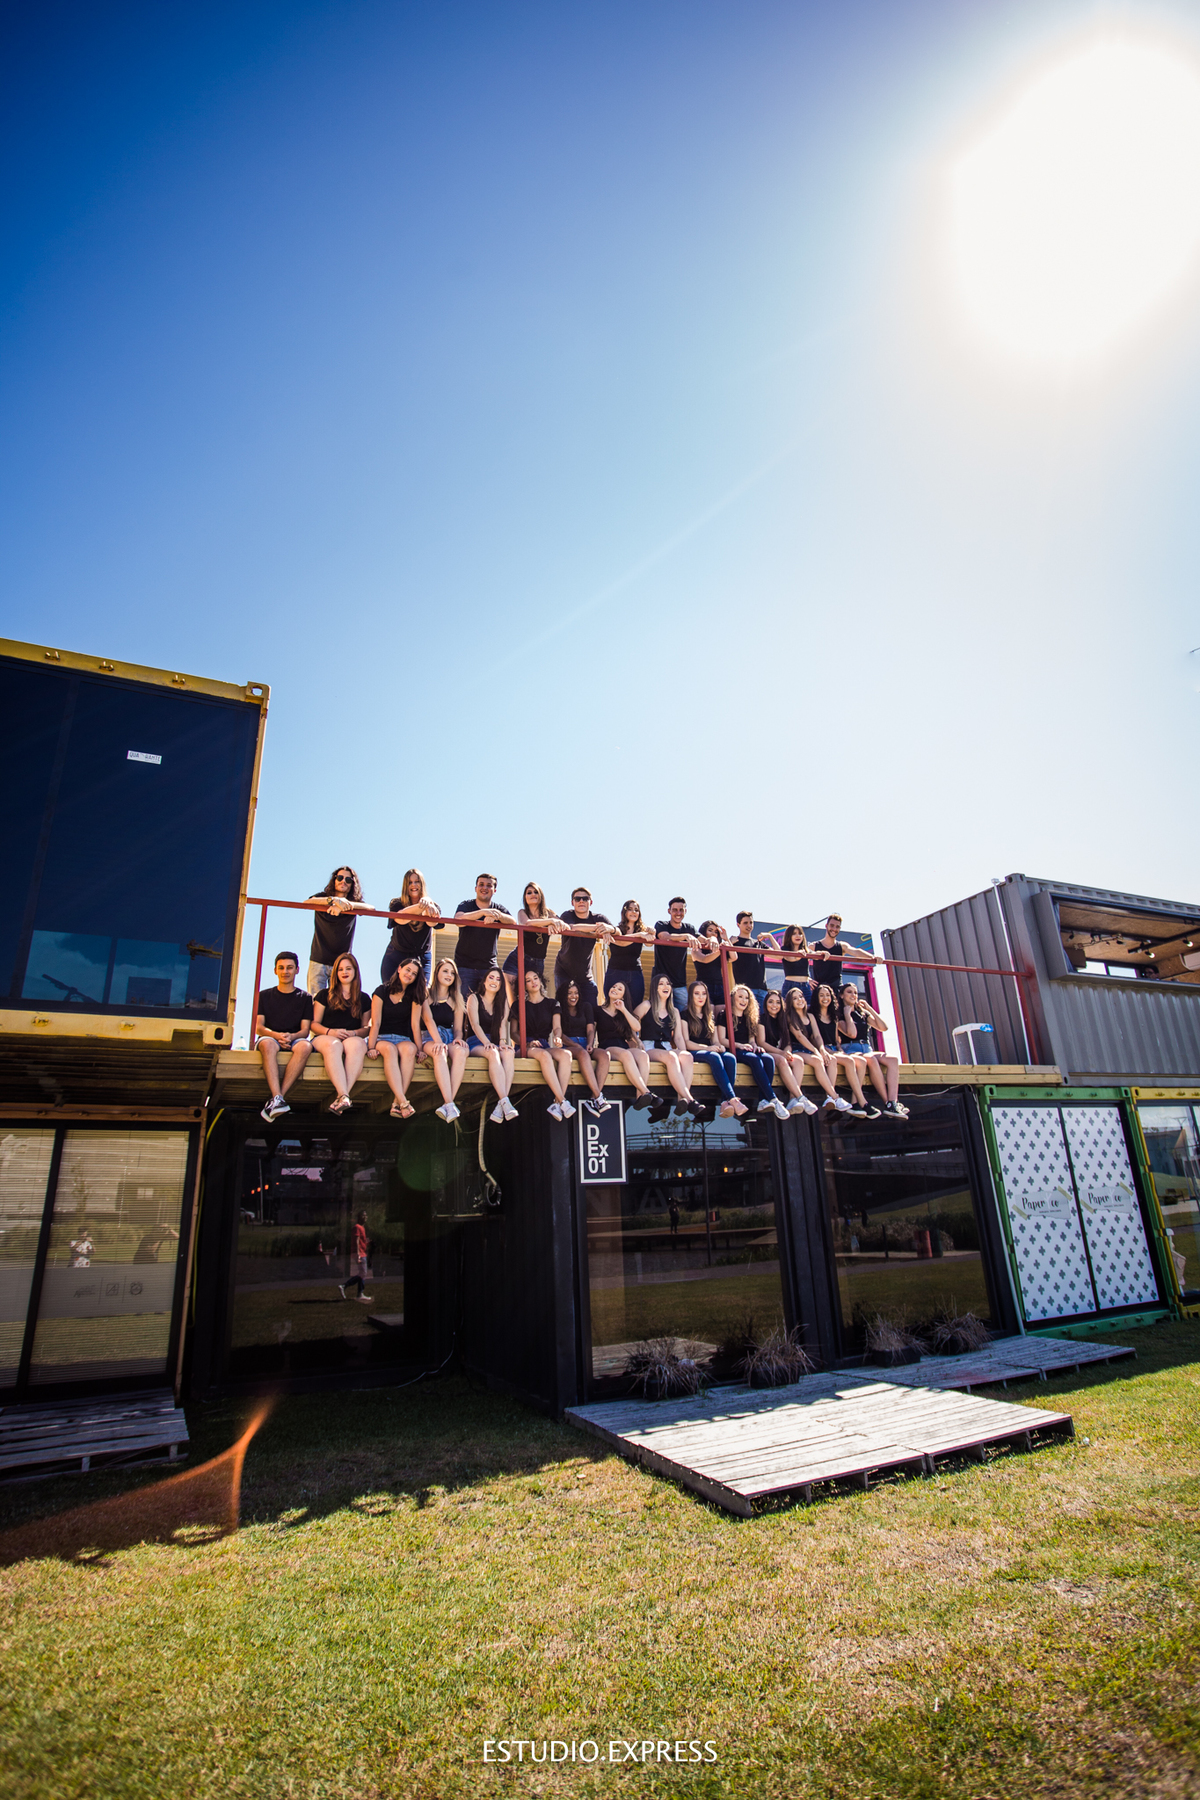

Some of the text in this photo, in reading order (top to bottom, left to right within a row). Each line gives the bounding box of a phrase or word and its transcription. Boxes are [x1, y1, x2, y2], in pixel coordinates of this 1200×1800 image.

[587, 1124, 600, 1140] D
[588, 1141, 609, 1157] Ex
[588, 1157, 606, 1174] 01
[1022, 1197, 1046, 1210] Paper
[1088, 1193, 1109, 1205] Paper
